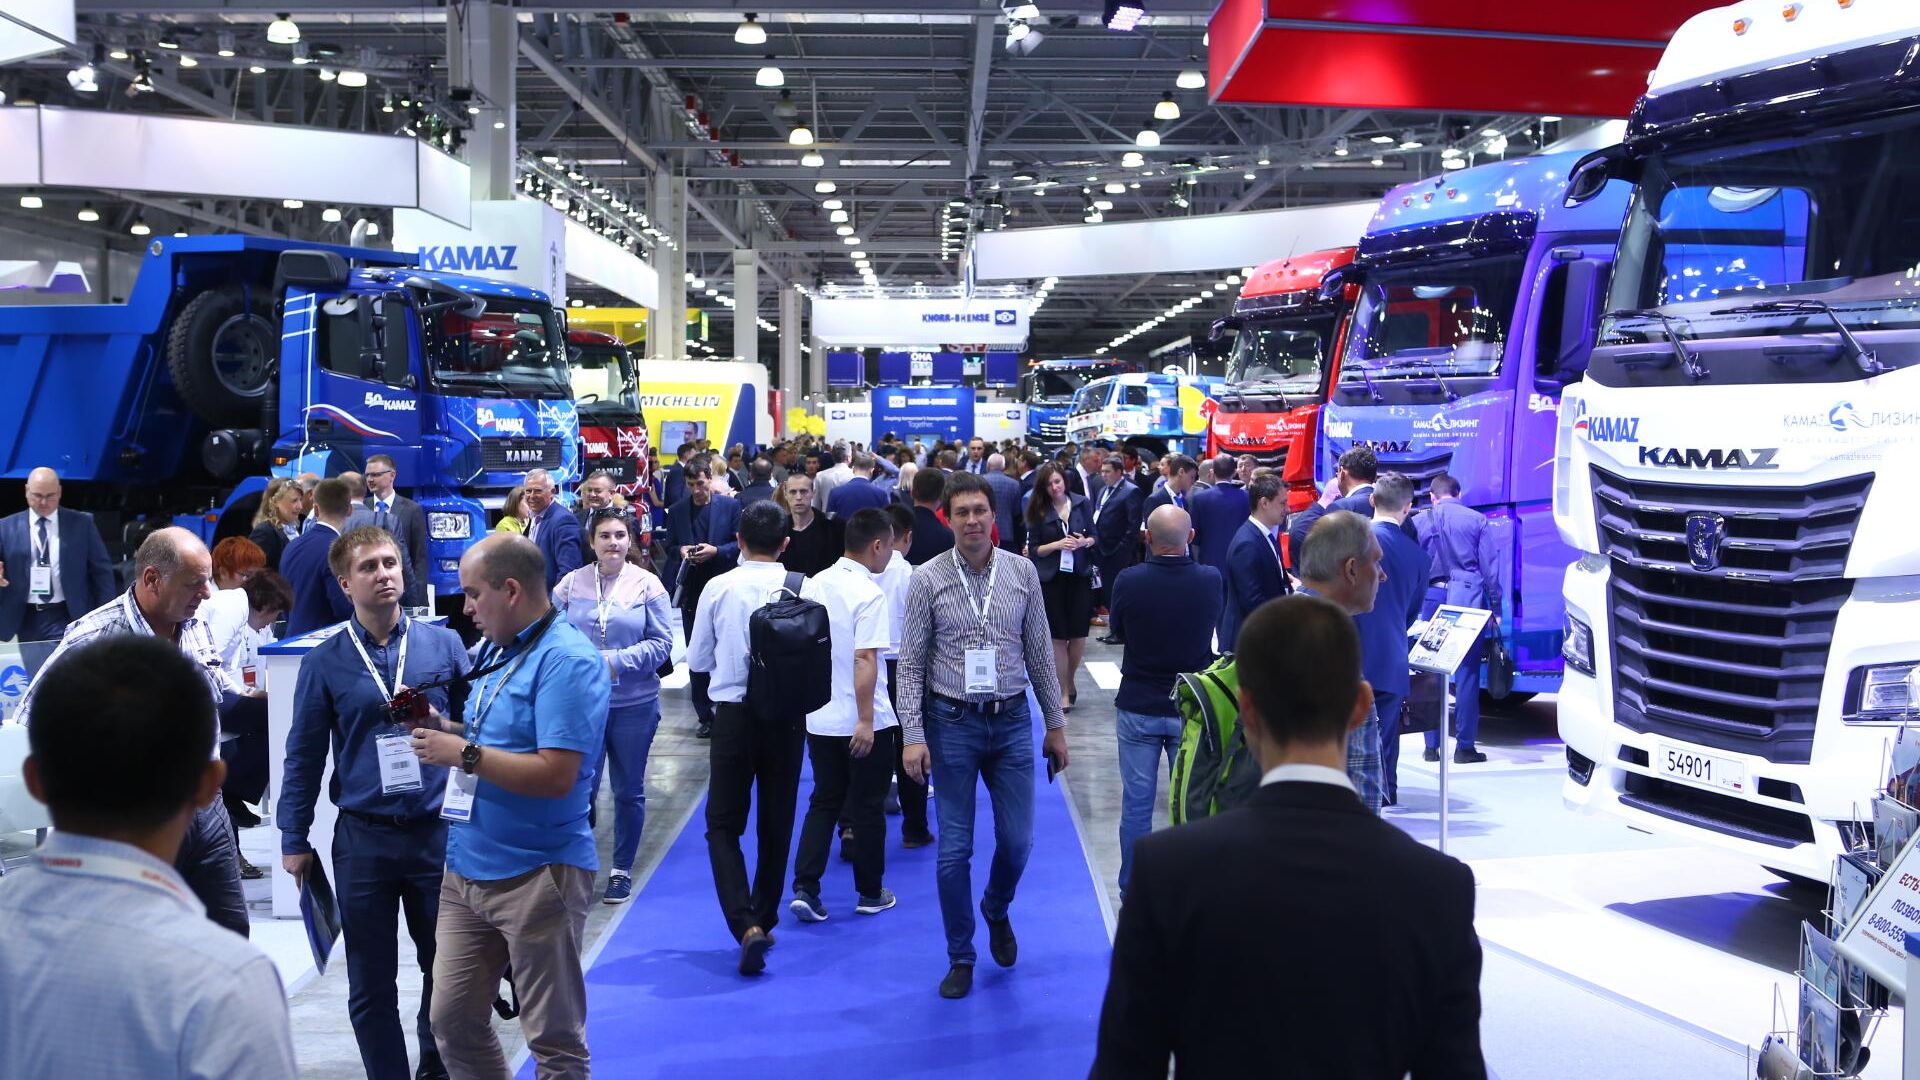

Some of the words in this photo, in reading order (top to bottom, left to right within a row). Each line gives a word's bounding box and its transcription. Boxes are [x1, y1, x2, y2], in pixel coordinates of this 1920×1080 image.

[419, 246, 517, 270] KAMAZ
[384, 400, 416, 411] KAMAZ
[640, 396, 690, 407] MICHELIN
[496, 418, 525, 431] KAMAZ
[1450, 419, 1480, 429] ЛИЗИНГ
[1588, 417, 1640, 443] KAMAZ
[506, 450, 543, 462] KAMAZ
[1639, 446, 1779, 470] KAMAZ
[596, 467, 624, 477] MAZ
[1668, 751, 1711, 781] 54901
[1899, 873, 1920, 891] ЕСТЬ
